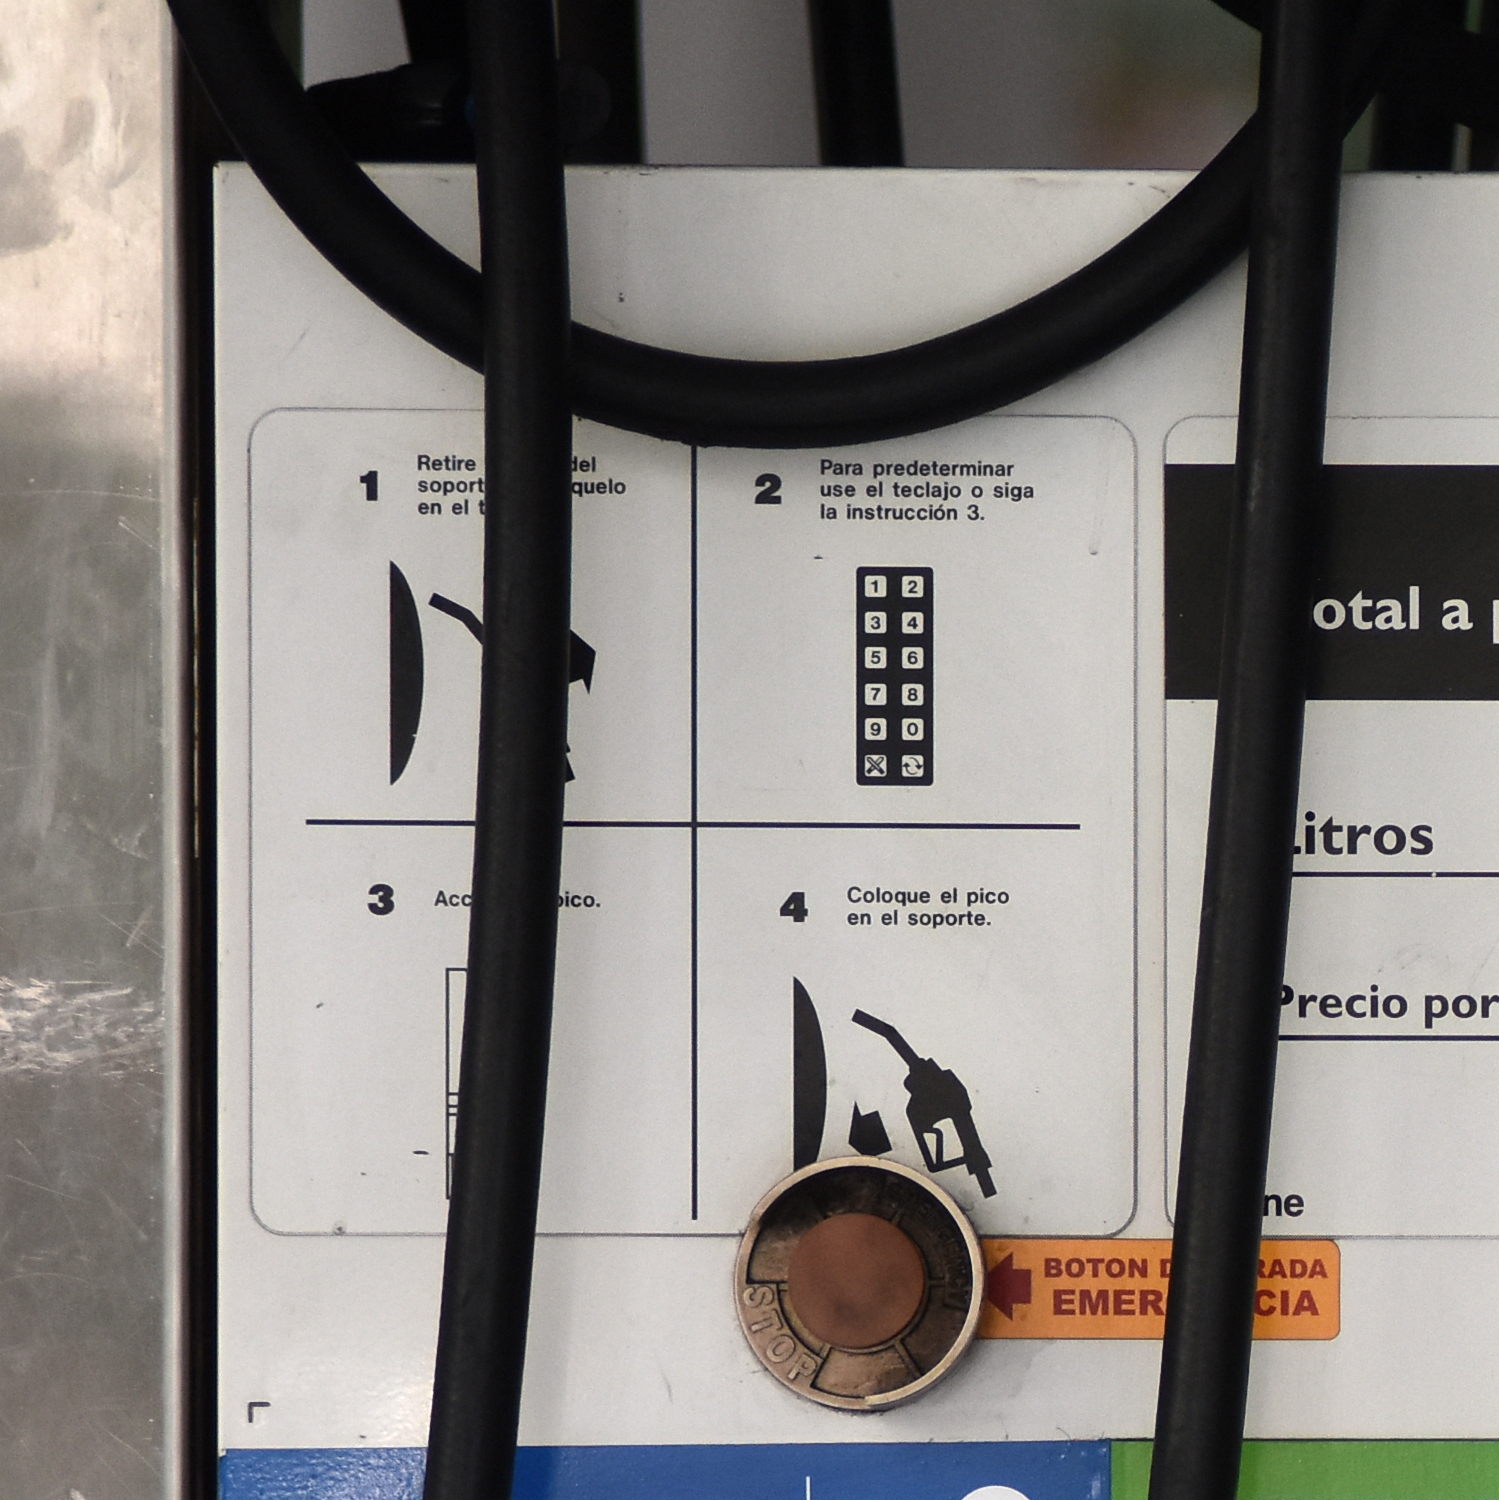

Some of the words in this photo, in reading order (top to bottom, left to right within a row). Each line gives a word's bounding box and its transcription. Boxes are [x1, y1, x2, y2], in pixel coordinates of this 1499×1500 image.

[416, 454, 477, 472] Retire
[819, 458, 864, 477] Para
[872, 460, 1015, 479] predeterminar
[359, 470, 379, 501] 1
[416, 477, 485, 497] soport
[572, 477, 627, 498] quelo
[753, 473, 783, 505] 2
[819, 483, 857, 499] use
[865, 481, 884, 499] el
[892, 481, 962, 502] teclajo
[970, 485, 984, 499] o
[992, 482, 1035, 503] siga
[416, 501, 442, 516] en
[451, 499, 469, 516] el
[819, 502, 838, 521] la
[846, 503, 958, 521] instrucción
[966, 504, 986, 521] 3.
[871, 580, 879, 594] 1
[907, 580, 919, 594] 2
[1312, 585, 1420, 630] otal
[1441, 598, 1474, 630] a
[870, 616, 881, 630] 3
[907, 616, 919, 630] 4
[870, 650, 881, 665] 5
[907, 650, 919, 665] 6
[870, 687, 881, 702] 7
[907, 687, 919, 702] 8
[870, 722, 881, 737] 9
[907, 722, 919, 737] 0
[1293, 810, 1435, 856] itros
[367, 883, 396, 917] 3
[779, 891, 809, 923] 4
[846, 886, 932, 907] Coloque
[939, 887, 958, 904] el
[966, 887, 1011, 908] pico
[846, 912, 872, 927] en
[880, 909, 899, 927] el
[907, 910, 993, 930] soporte.
[1423, 993, 1498, 1029] por
[1043, 1257, 1148, 1279] BOTON
[1052, 1288, 1321, 1317] EMERCIA
[743, 1286, 818, 1382] STOP
